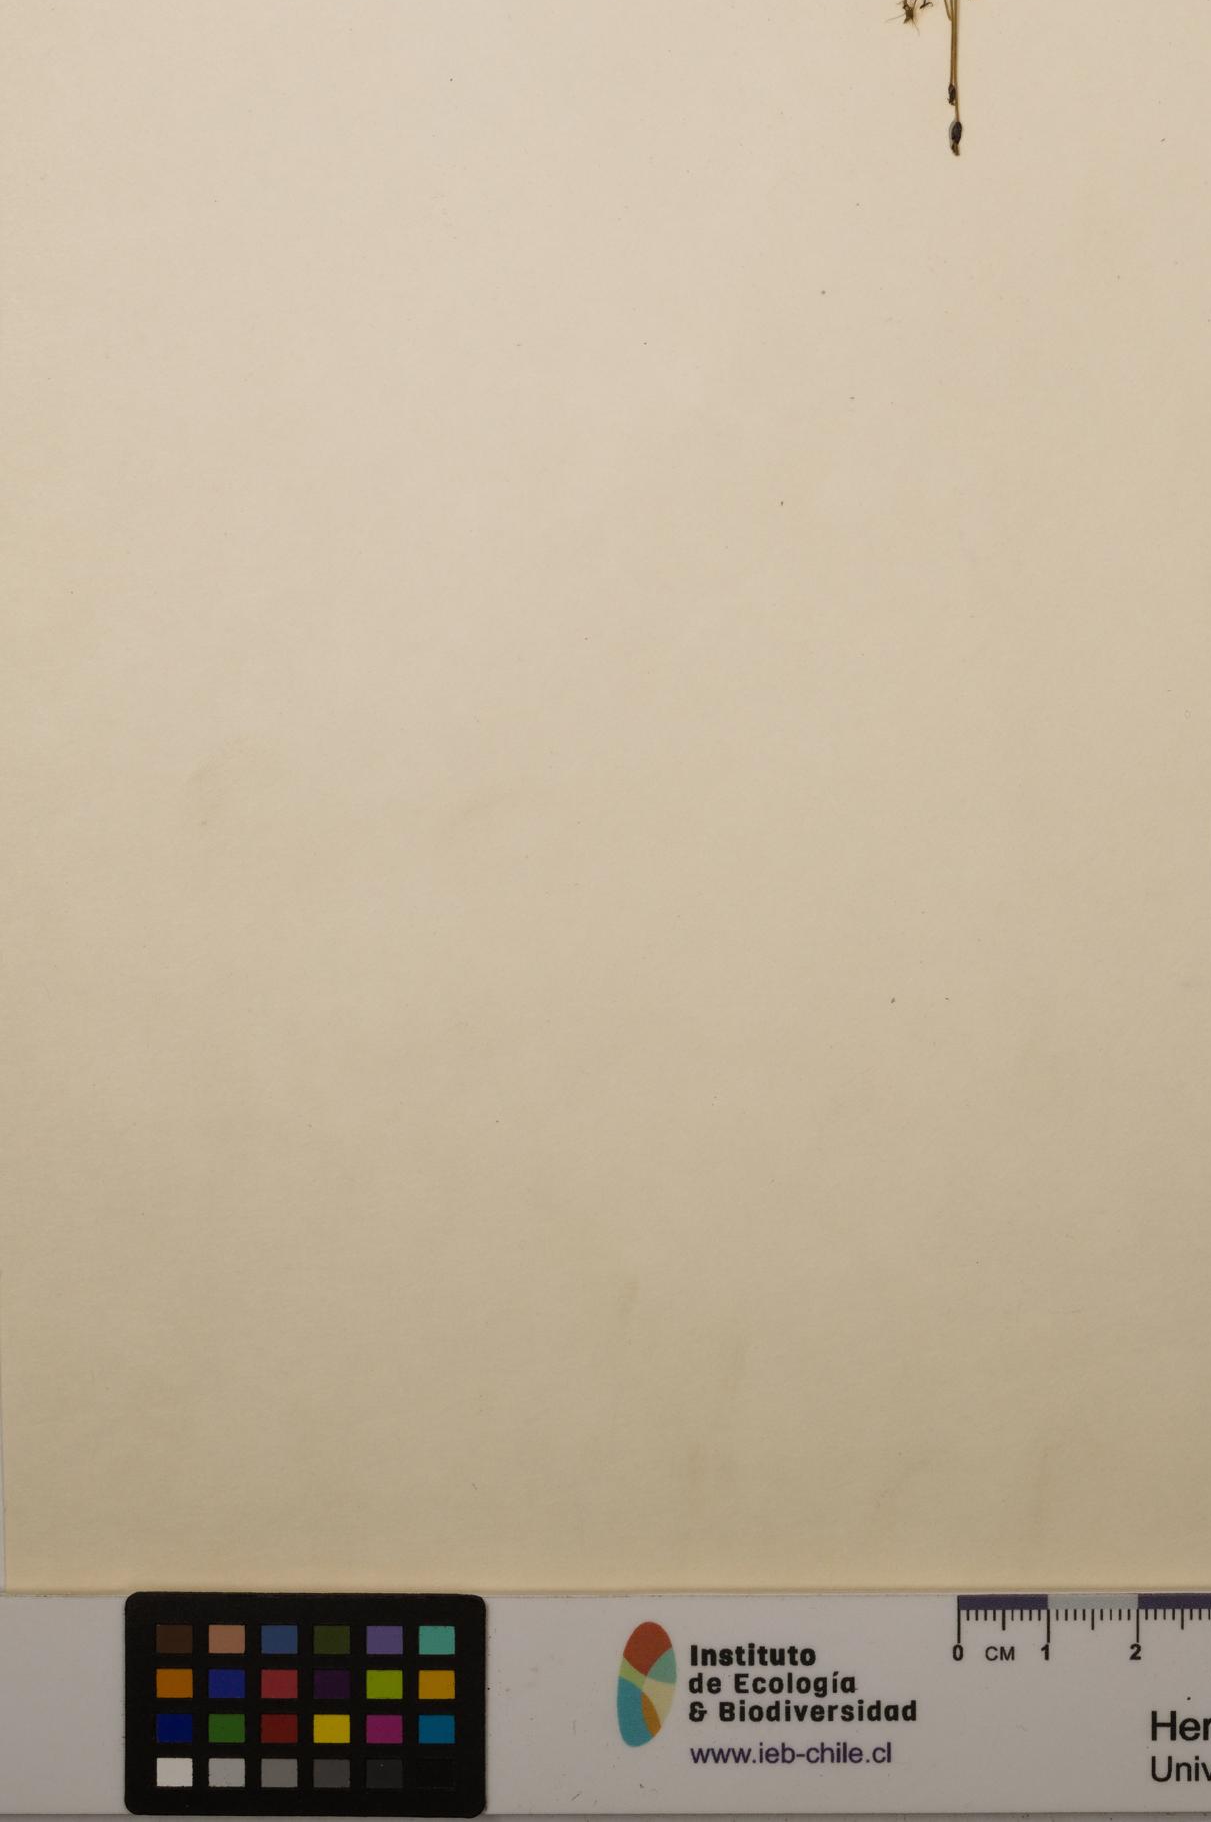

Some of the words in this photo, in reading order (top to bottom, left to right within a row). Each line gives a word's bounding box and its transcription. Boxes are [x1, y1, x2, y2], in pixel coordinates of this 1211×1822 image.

[690, 1642, 817, 1667] Instituto
[952, 1642, 964, 1662] 0
[984, 1645, 1016, 1662] CM
[1041, 1642, 1051, 1662] 1
[1129, 1642, 1142, 1661] 2
[688, 1672, 722, 1695] de
[733, 1671, 858, 1698] Ecología
[688, 1700, 708, 1723] &
[718, 1699, 917, 1723] Biodiversidad
[689, 1741, 892, 1765] www.ieb-chile.cl
